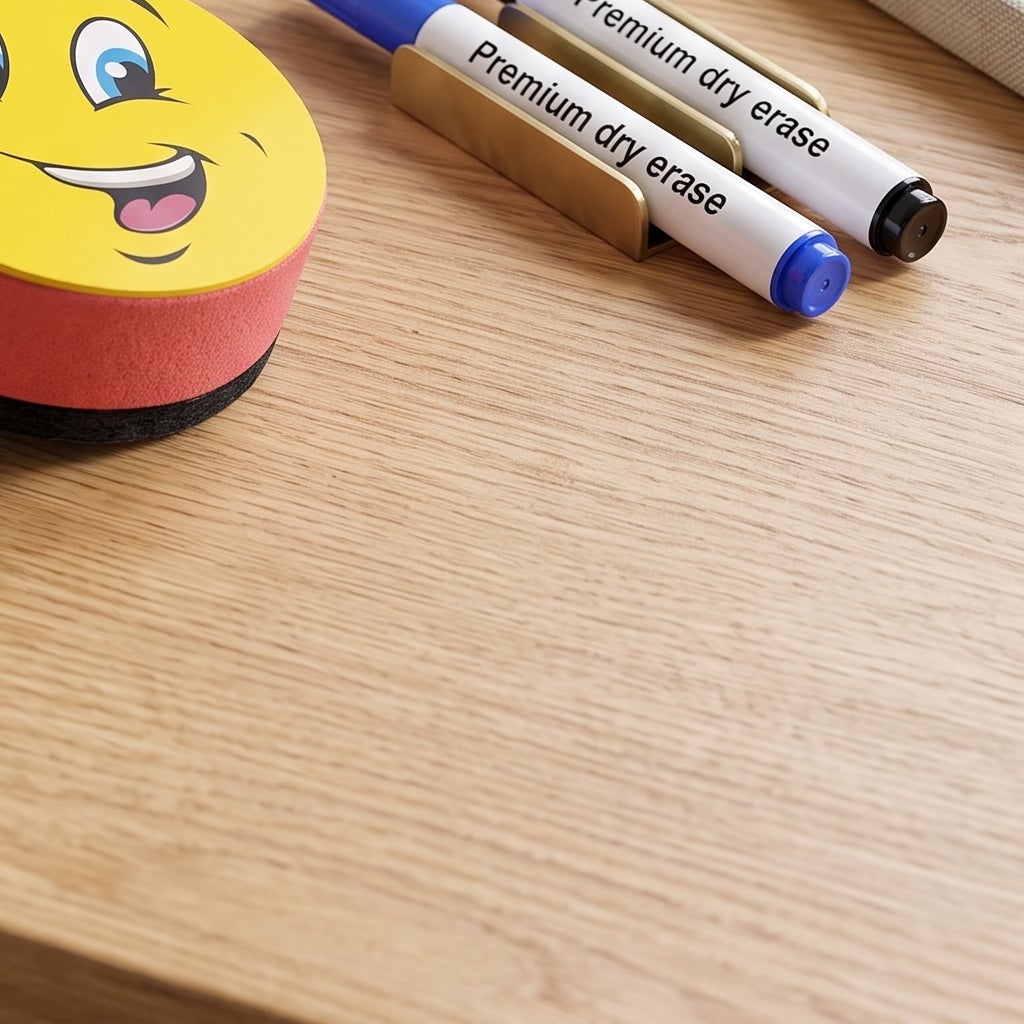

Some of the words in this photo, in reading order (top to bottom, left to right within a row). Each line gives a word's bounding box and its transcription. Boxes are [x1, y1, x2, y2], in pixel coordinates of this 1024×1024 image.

[467, 39, 594, 134] Premium
[593, 123, 648, 170] dry
[645, 155, 728, 216] erase
[697, 67, 751, 110] dry
[749, 100, 831, 159] erase
